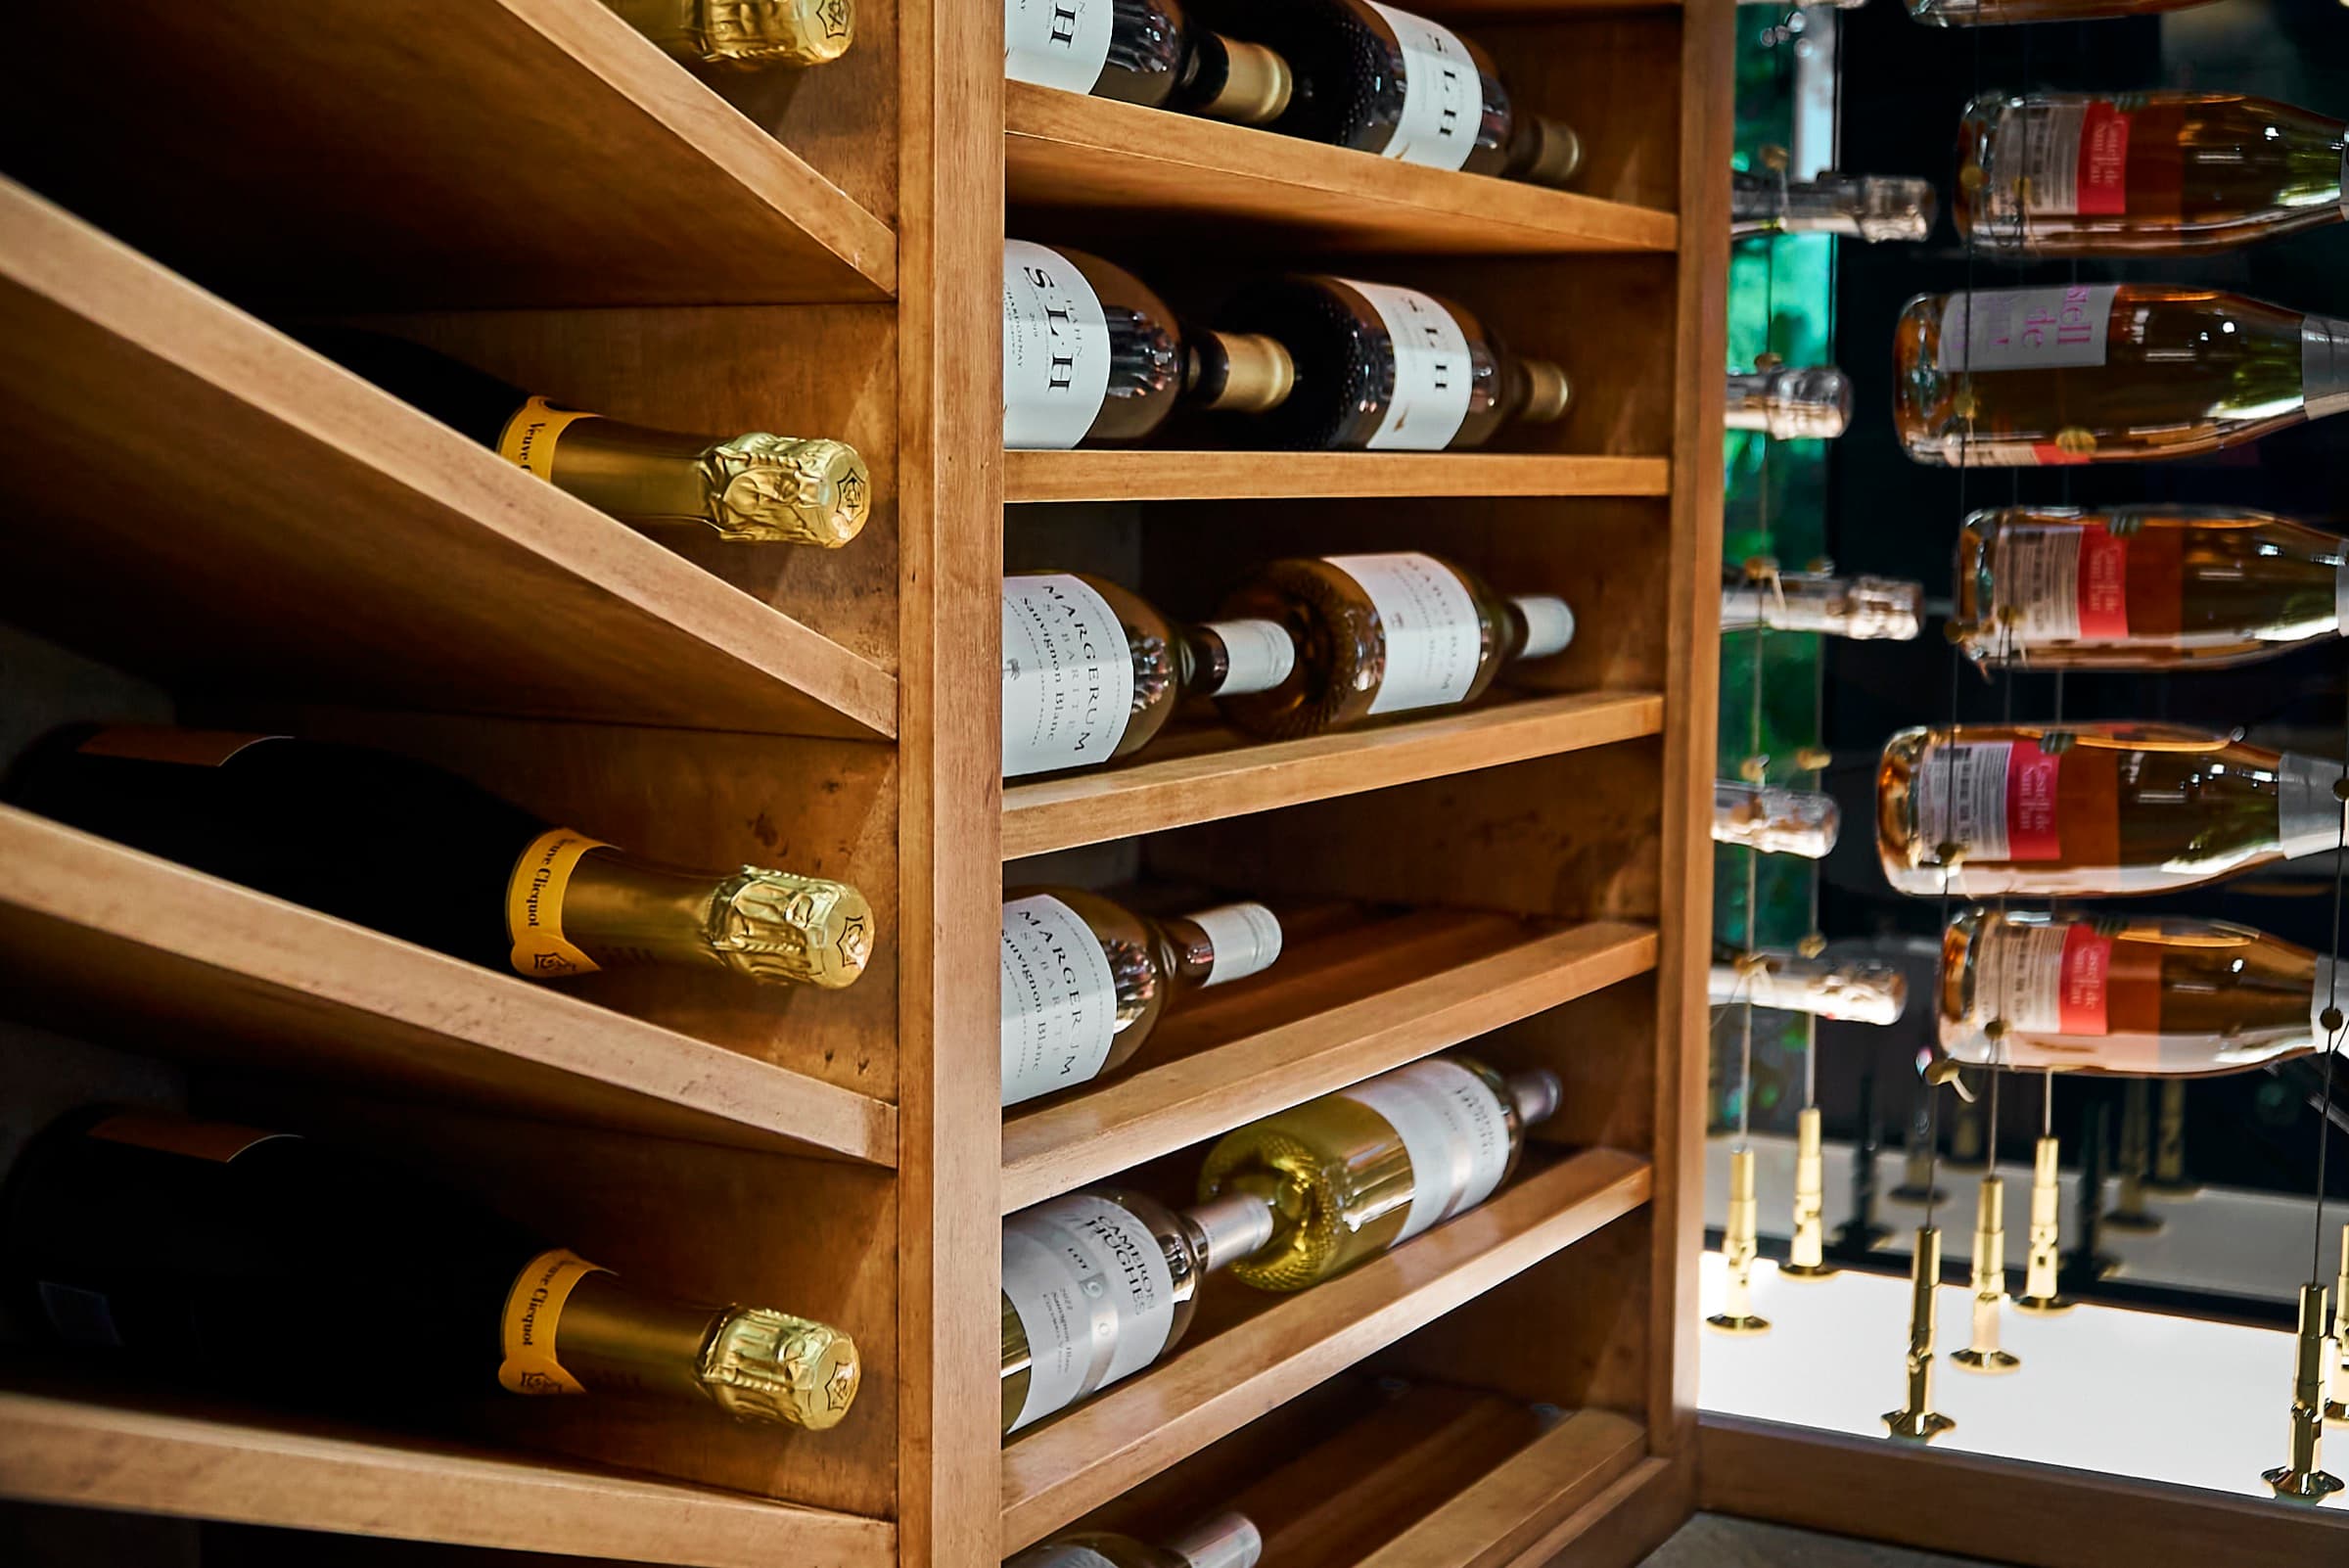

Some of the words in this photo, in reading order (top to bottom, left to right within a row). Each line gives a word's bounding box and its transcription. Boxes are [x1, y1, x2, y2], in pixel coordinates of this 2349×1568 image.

[520, 423, 545, 461] Veuve
[1042, 584, 1100, 751] MARGERUM
[1047, 692, 1064, 742] Blanc
[526, 868, 551, 928] Clicquot
[1033, 1022, 1047, 1072] Blanc
[1085, 1219, 1145, 1315] HUGHES
[1098, 1215, 1155, 1311] CAMERON
[522, 1288, 548, 1347] Clicquot
